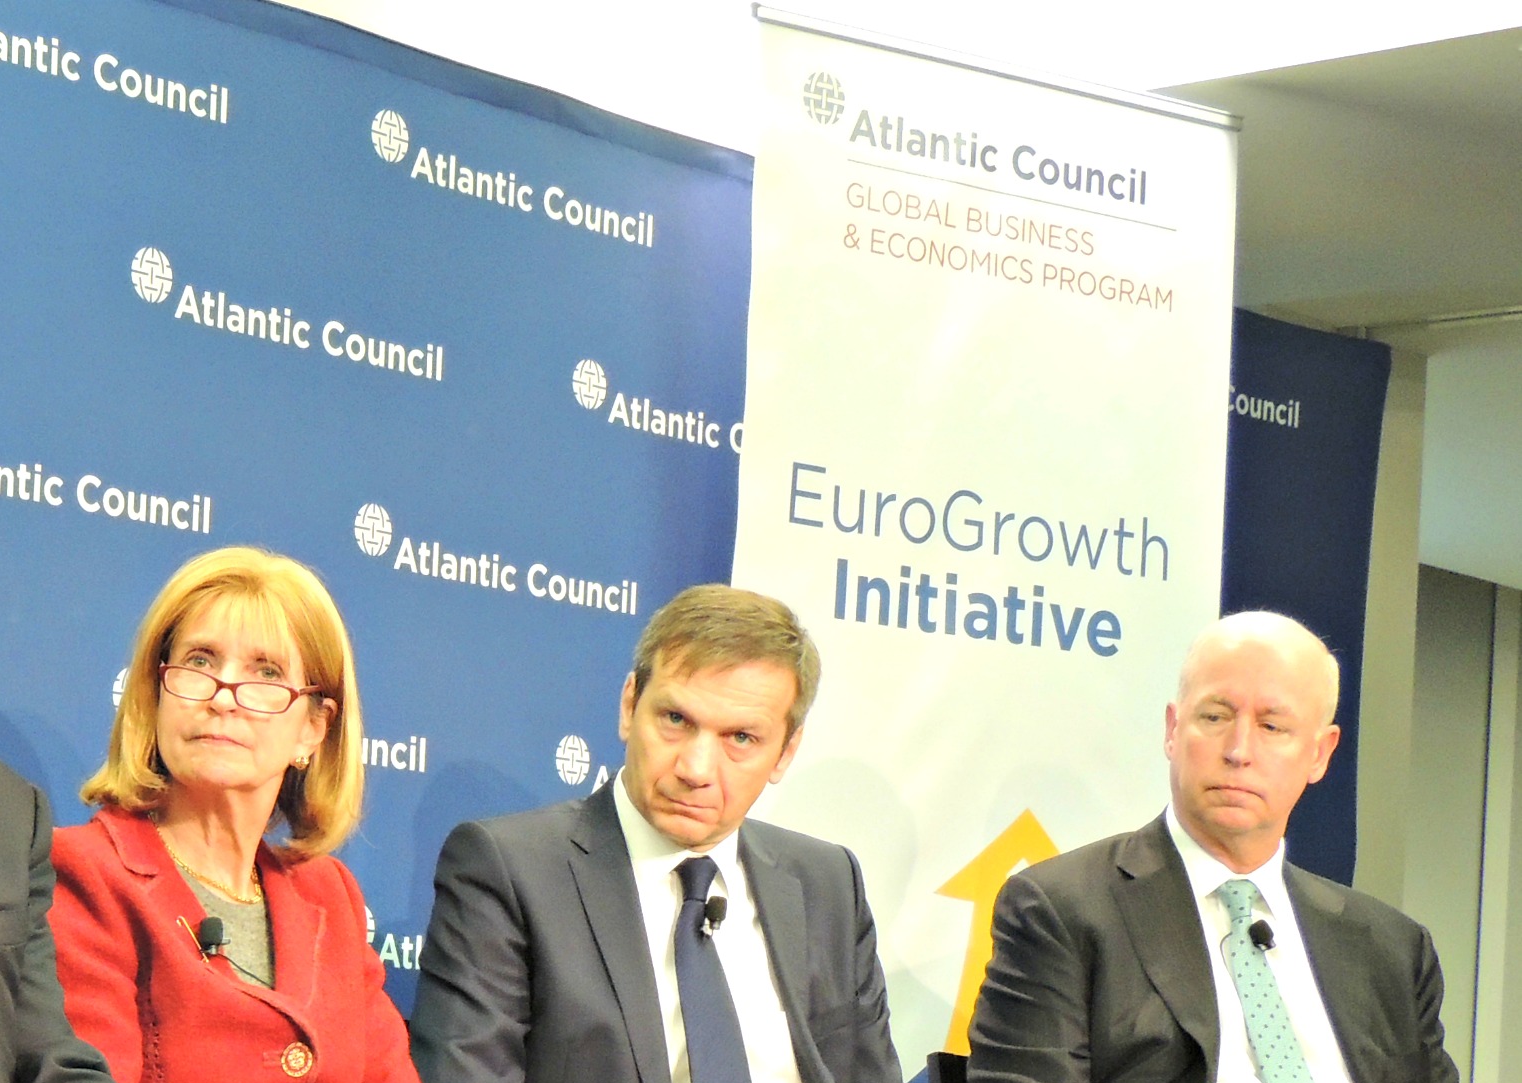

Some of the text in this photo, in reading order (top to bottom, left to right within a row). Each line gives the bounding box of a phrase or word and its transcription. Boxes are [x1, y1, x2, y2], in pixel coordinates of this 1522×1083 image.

[93, 53, 229, 124] Council
[411, 147, 654, 248] Atlantic Council
[849, 110, 1147, 205] Atlantic Council
[846, 182, 1094, 256] GLOBAL BUSINESS
[843, 223, 1173, 312] & ECONOMICS PROGRAM
[174, 285, 444, 382] Atlantic Council
[607, 393, 720, 448] Atlantic
[76, 474, 212, 534] Council
[788, 461, 1169, 581] EuroGrowth
[393, 537, 638, 616] Atlantic Council
[833, 558, 1122, 657] Initiative
